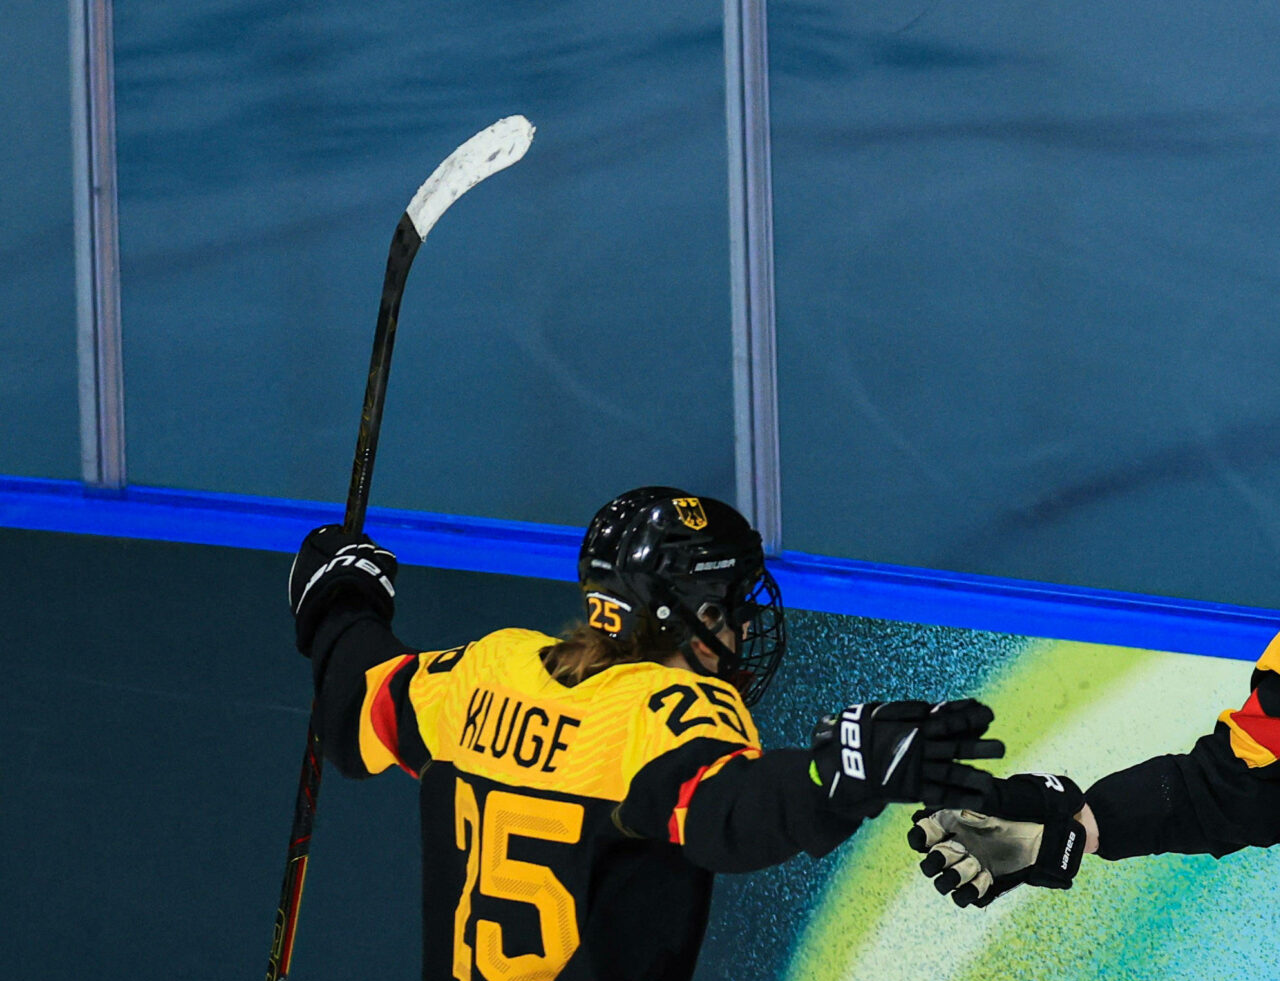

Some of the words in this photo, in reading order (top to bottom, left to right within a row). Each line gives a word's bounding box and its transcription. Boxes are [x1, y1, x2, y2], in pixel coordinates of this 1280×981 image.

[588, 597, 622, 634] 25
[459, 687, 581, 773] KLUGE
[647, 681, 751, 743] 25
